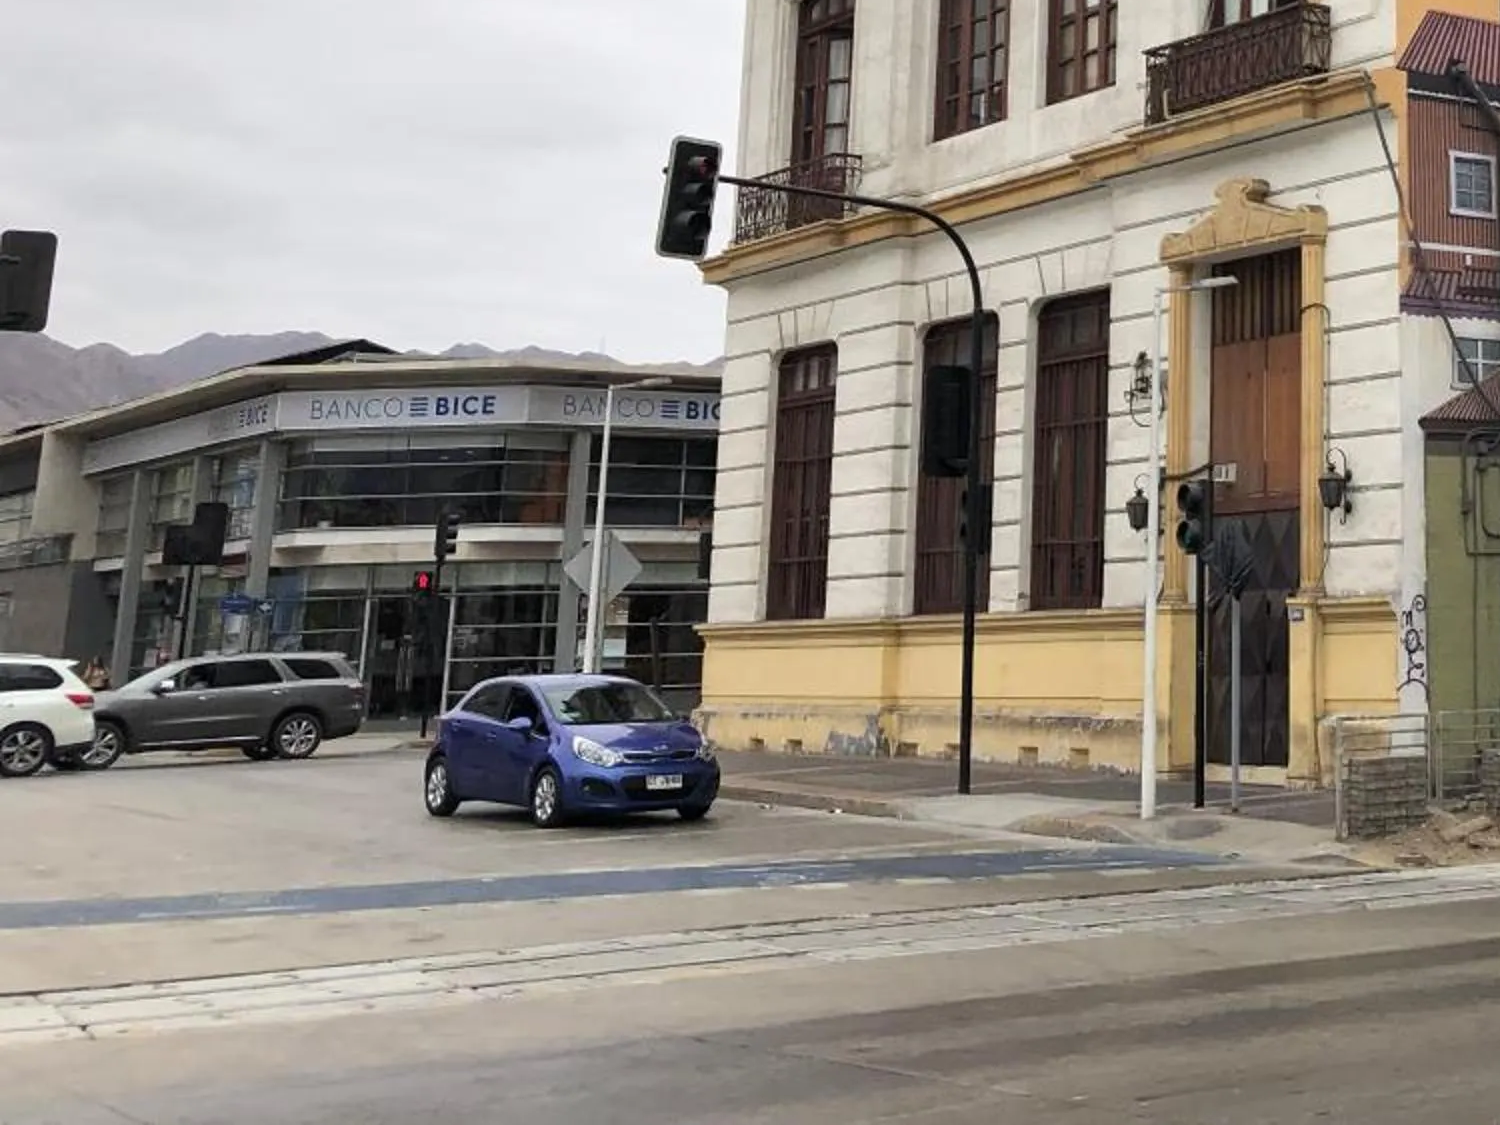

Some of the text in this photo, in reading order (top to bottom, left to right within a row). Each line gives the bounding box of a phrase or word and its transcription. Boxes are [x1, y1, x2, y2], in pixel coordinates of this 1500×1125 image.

[310, 395, 496, 420] BANCO BICE
[685, 400, 721, 420] BIC
